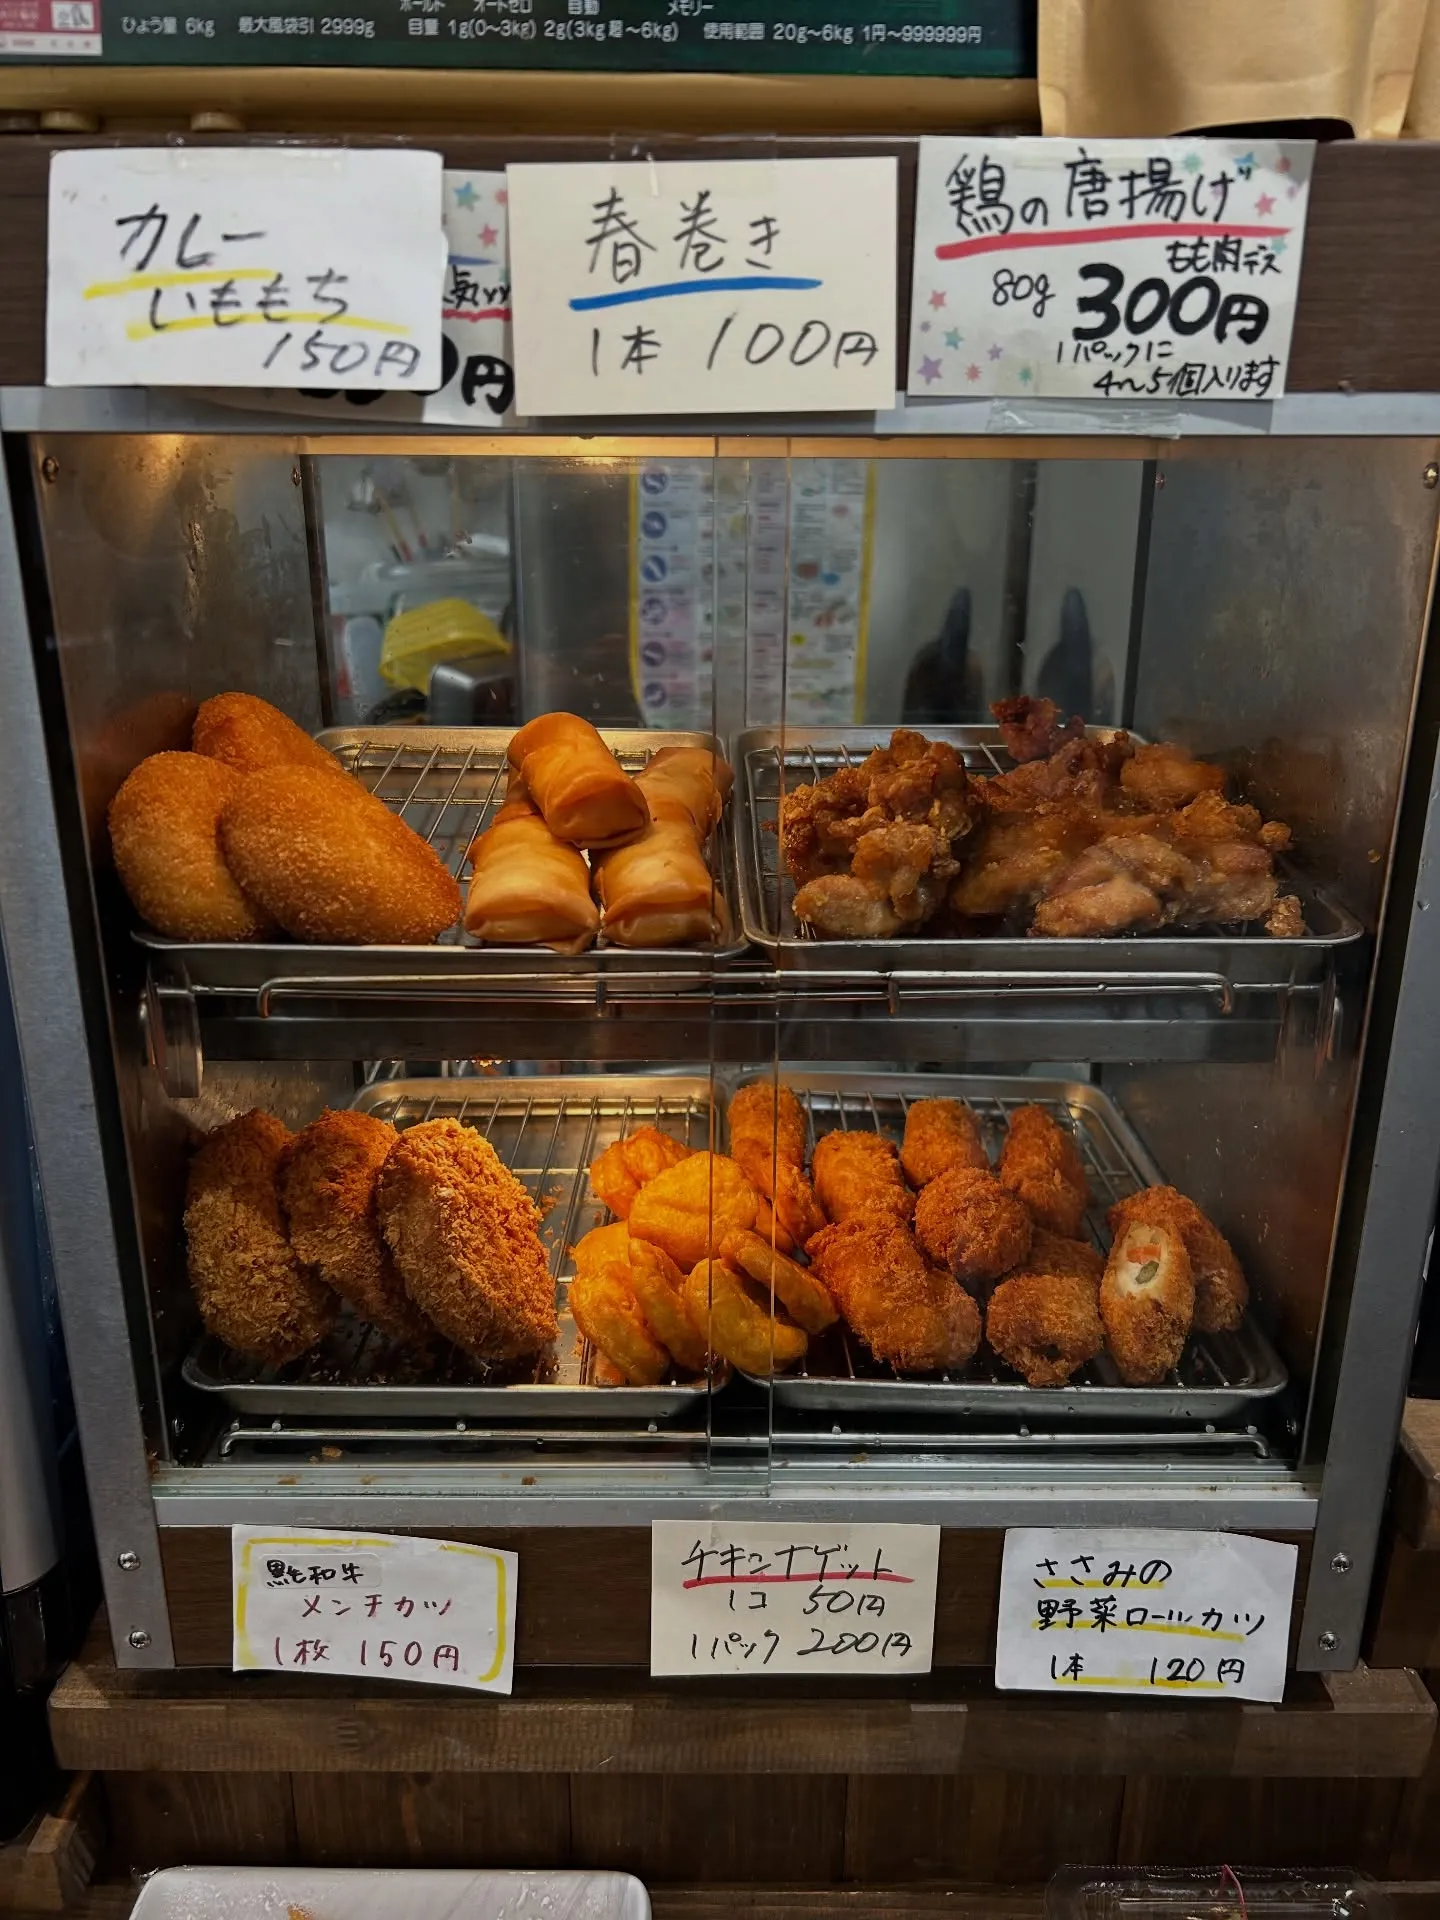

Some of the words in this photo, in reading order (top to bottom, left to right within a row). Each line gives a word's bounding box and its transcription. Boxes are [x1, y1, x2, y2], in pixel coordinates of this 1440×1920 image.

[122, 16, 177, 34] ひょう量
[185, 17, 215, 37] 6kg
[320, 17, 375, 38] 2999g
[408, 17, 439, 36] 目量
[703, 22, 764, 41] 使用範囲
[945, 147, 1252, 236] 鶏の唐揚げ
[116, 203, 267, 272] カレー
[586, 187, 778, 284] 春巻き
[150, 269, 350, 330] いももち
[992, 268, 1056, 319] 80g
[1072, 262, 1269, 345] 300円
[263, 330, 421, 378] 150円
[593, 325, 660, 374] 1本
[706, 310, 878, 369] 100円
[680, 1539, 893, 1583] チキンナゲット
[1032, 1554, 1173, 1589] ささみの
[301, 1593, 452, 1619] メンチカツ
[728, 1589, 768, 1612] 1コ
[802, 1579, 886, 1618] 50円
[1037, 1594, 1265, 1636] 野菜ロールカツ
[274, 1636, 330, 1666] 1枚
[360, 1639, 460, 1672] 150円
[796, 1627, 913, 1658] 200円
[1050, 1652, 1084, 1682] 1本
[1149, 1656, 1245, 1685] 120円
